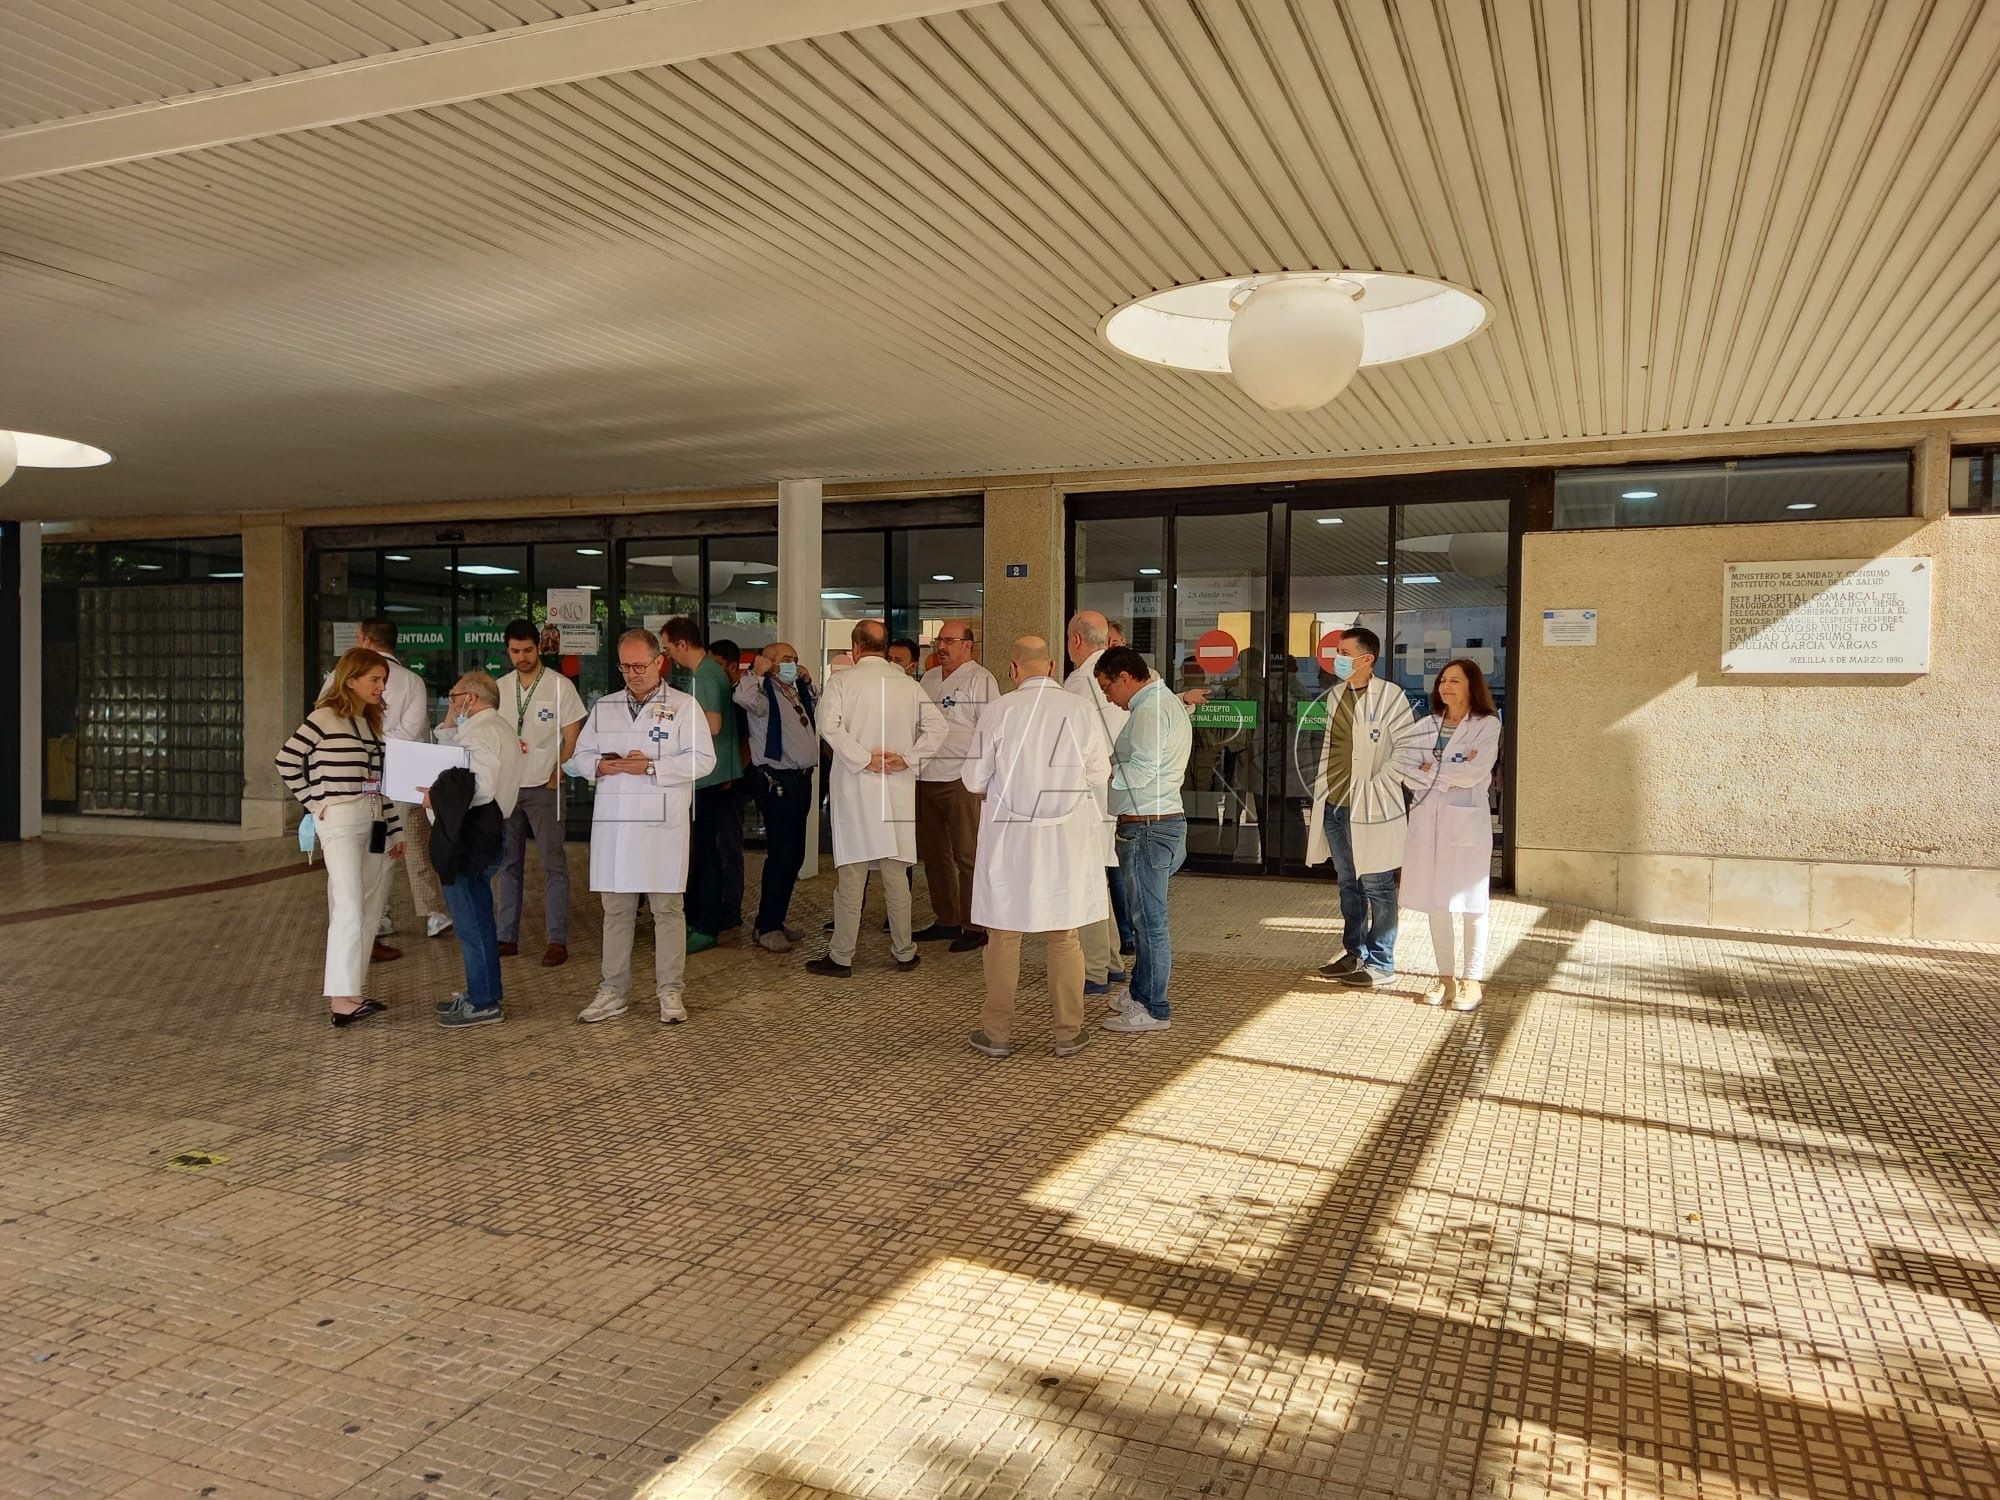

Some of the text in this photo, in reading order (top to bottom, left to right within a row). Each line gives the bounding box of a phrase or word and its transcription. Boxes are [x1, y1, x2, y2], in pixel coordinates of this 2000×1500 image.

[1013, 566, 1020, 576] 2
[1731, 569, 1890, 581] MINISTERIO DE SANIDAD Y CONSUMO
[1779, 579, 1825, 587] NACIONAL
[1841, 578, 1853, 586] LA
[1855, 577, 1884, 586] SALUD
[1754, 593, 1808, 602] HOSPITAL
[1811, 591, 1878, 602] COMARCAL
[1881, 592, 1898, 600] FUE
[1730, 602, 1786, 610] INAUGURADO
[1848, 600, 1868, 608] HOY
[1872, 600, 1904, 608] SIENDO
[1729, 609, 1773, 617] DELEGADO
[1794, 608, 1839, 616] GOBIERNO
[1856, 607, 1894, 615] MELILLA
[1897, 606, 1908, 614] EL
[1729, 626, 1746, 634] POR
[1880, 622, 1896, 632] DE
[396, 633, 444, 643] ENTRADA
[1729, 632, 1780, 642] SANIDAD
[1783, 632, 1791, 641] Y
[1829, 640, 1878, 650] VARGAS
[1789, 656, 1826, 664] MELILLA
[1849, 656, 1884, 664] MARZO
[1886, 656, 1904, 664] 1990
[1201, 705, 1230, 713] EXCEPTO
[1212, 715, 1254, 723] AUTORIZADO
